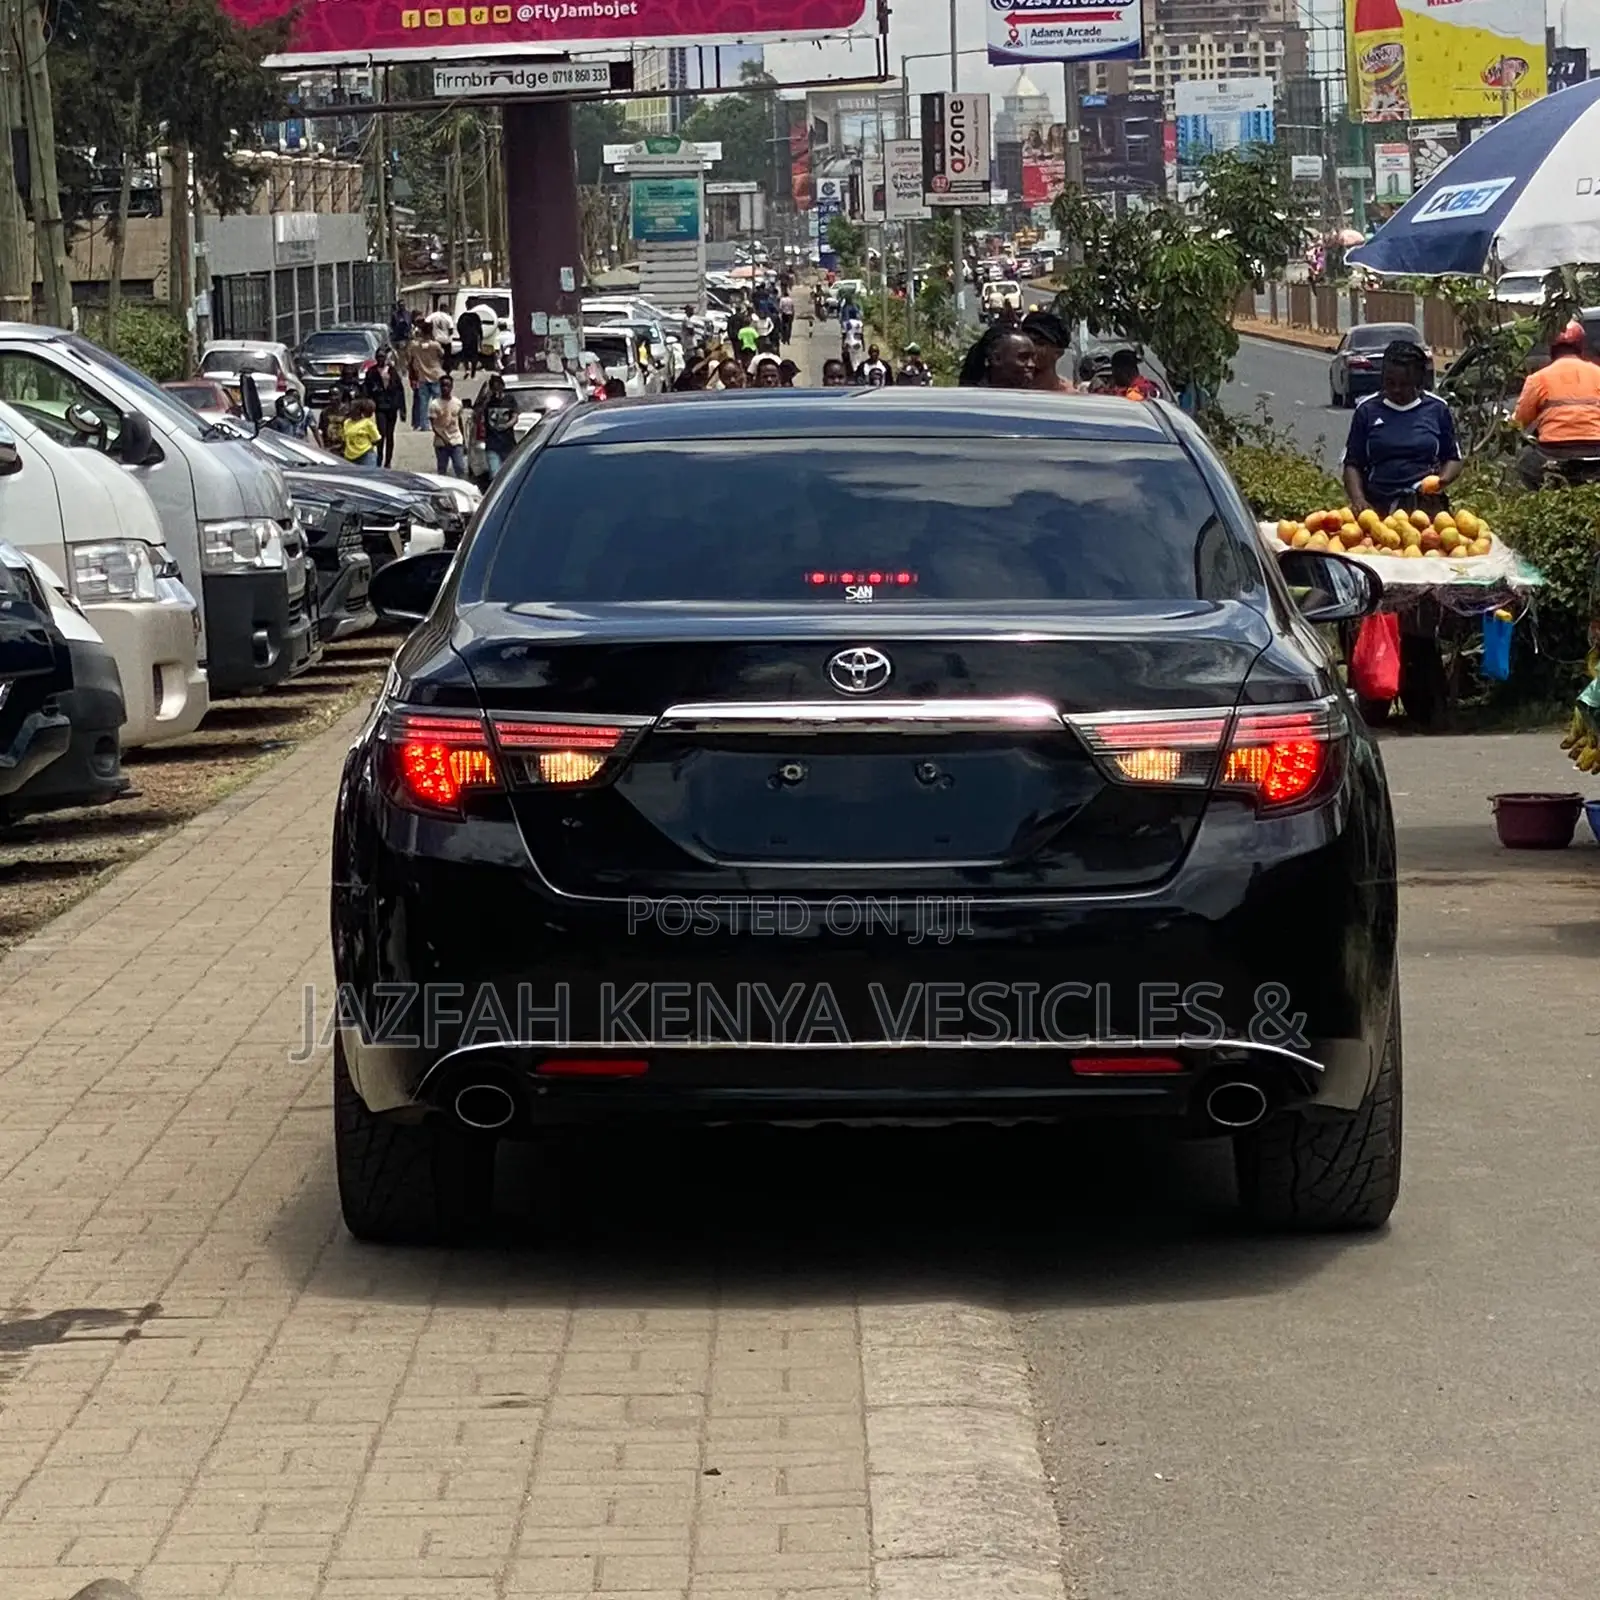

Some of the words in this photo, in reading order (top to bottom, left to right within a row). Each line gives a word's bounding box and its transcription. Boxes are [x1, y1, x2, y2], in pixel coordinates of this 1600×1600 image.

[516, 1, 638, 22] @FlyJambojet
[1031, 27, 1063, 38] Adams
[1066, 25, 1102, 37] Arcade
[436, 69, 549, 89] firmbrdge
[552, 70, 573, 84] 0718
[592, 68, 607, 82] 333
[950, 99, 966, 174] azone
[1423, 185, 1505, 215] 1XBET
